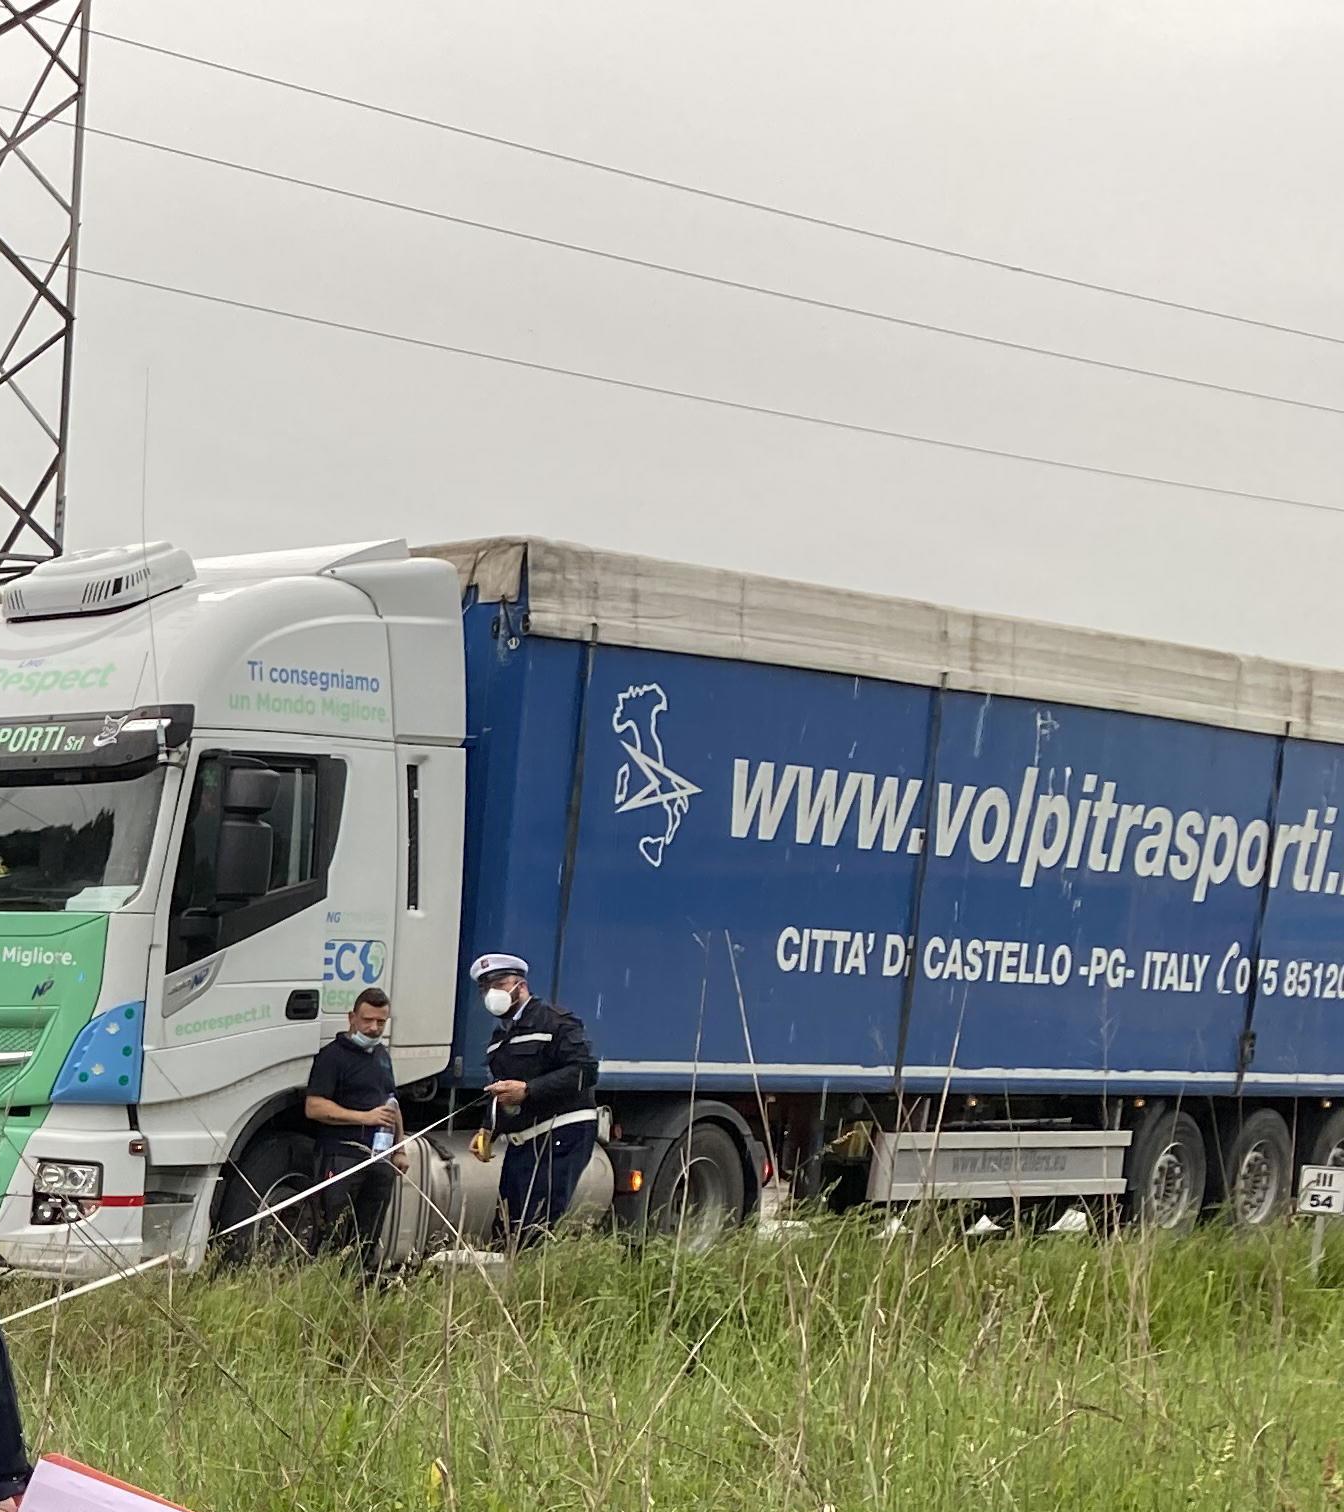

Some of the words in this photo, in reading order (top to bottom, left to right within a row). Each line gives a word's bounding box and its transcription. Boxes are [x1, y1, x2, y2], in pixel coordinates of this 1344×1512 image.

[247, 660, 263, 681] Ti
[269, 667, 380, 693] consegniamo
[229, 694, 250, 710] un
[256, 692, 316, 715] Mondo
[730, 758, 1344, 902] www.volpitrasporti.
[775, 926, 876, 976] CITTA'
[923, 936, 1072, 986] CASTELLO
[1141, 950, 1211, 993] ITALY
[1309, 1194, 1333, 1209] 54
